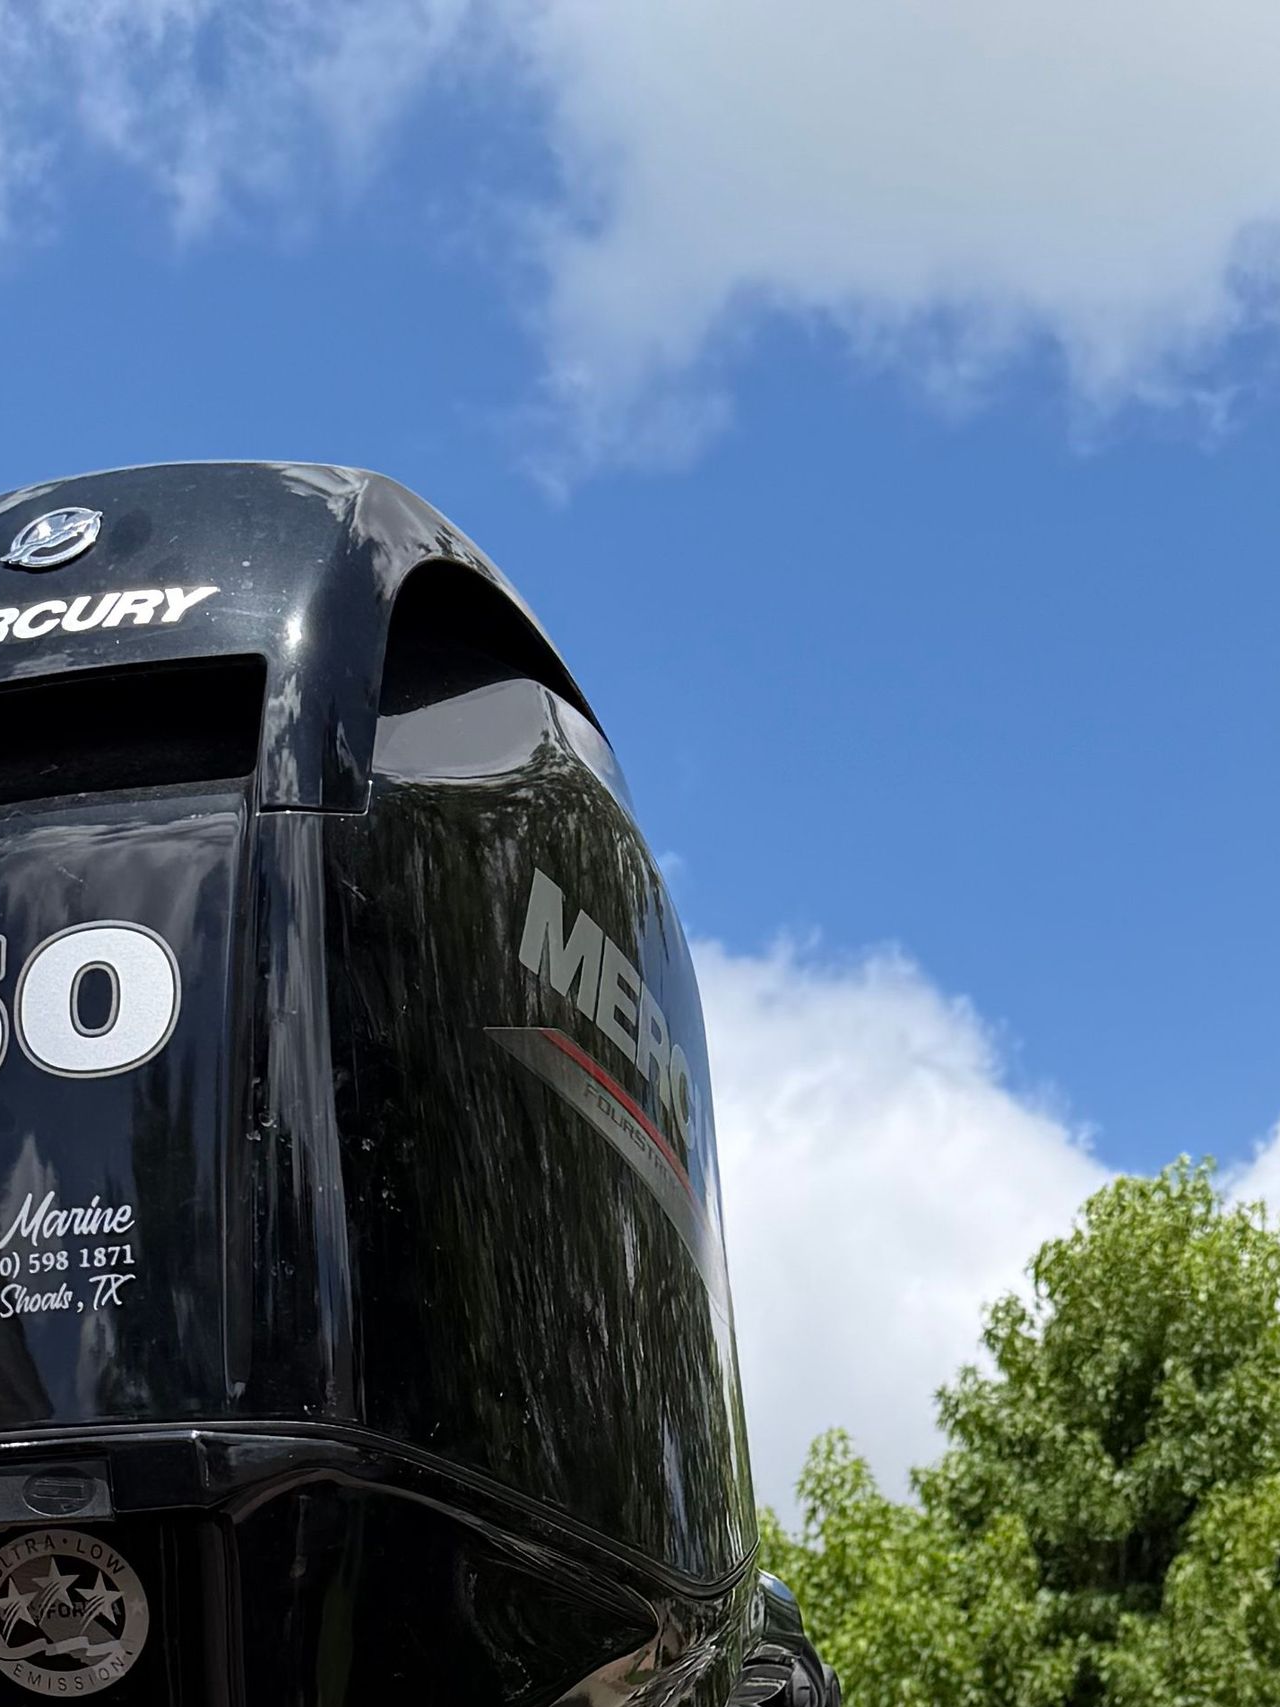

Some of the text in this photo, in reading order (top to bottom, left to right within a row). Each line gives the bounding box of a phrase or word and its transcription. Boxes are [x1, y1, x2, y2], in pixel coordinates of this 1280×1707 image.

[518, 867, 710, 1160] MERC
[583, 1081, 672, 1183] FOURSTR
[28, 1249, 69, 1274] 598
[79, 1244, 136, 1268] 1871
[89, 1273, 136, 1311] TX
[75, 1537, 126, 1576] LOW
[12, 1657, 125, 1693] EMISSION
